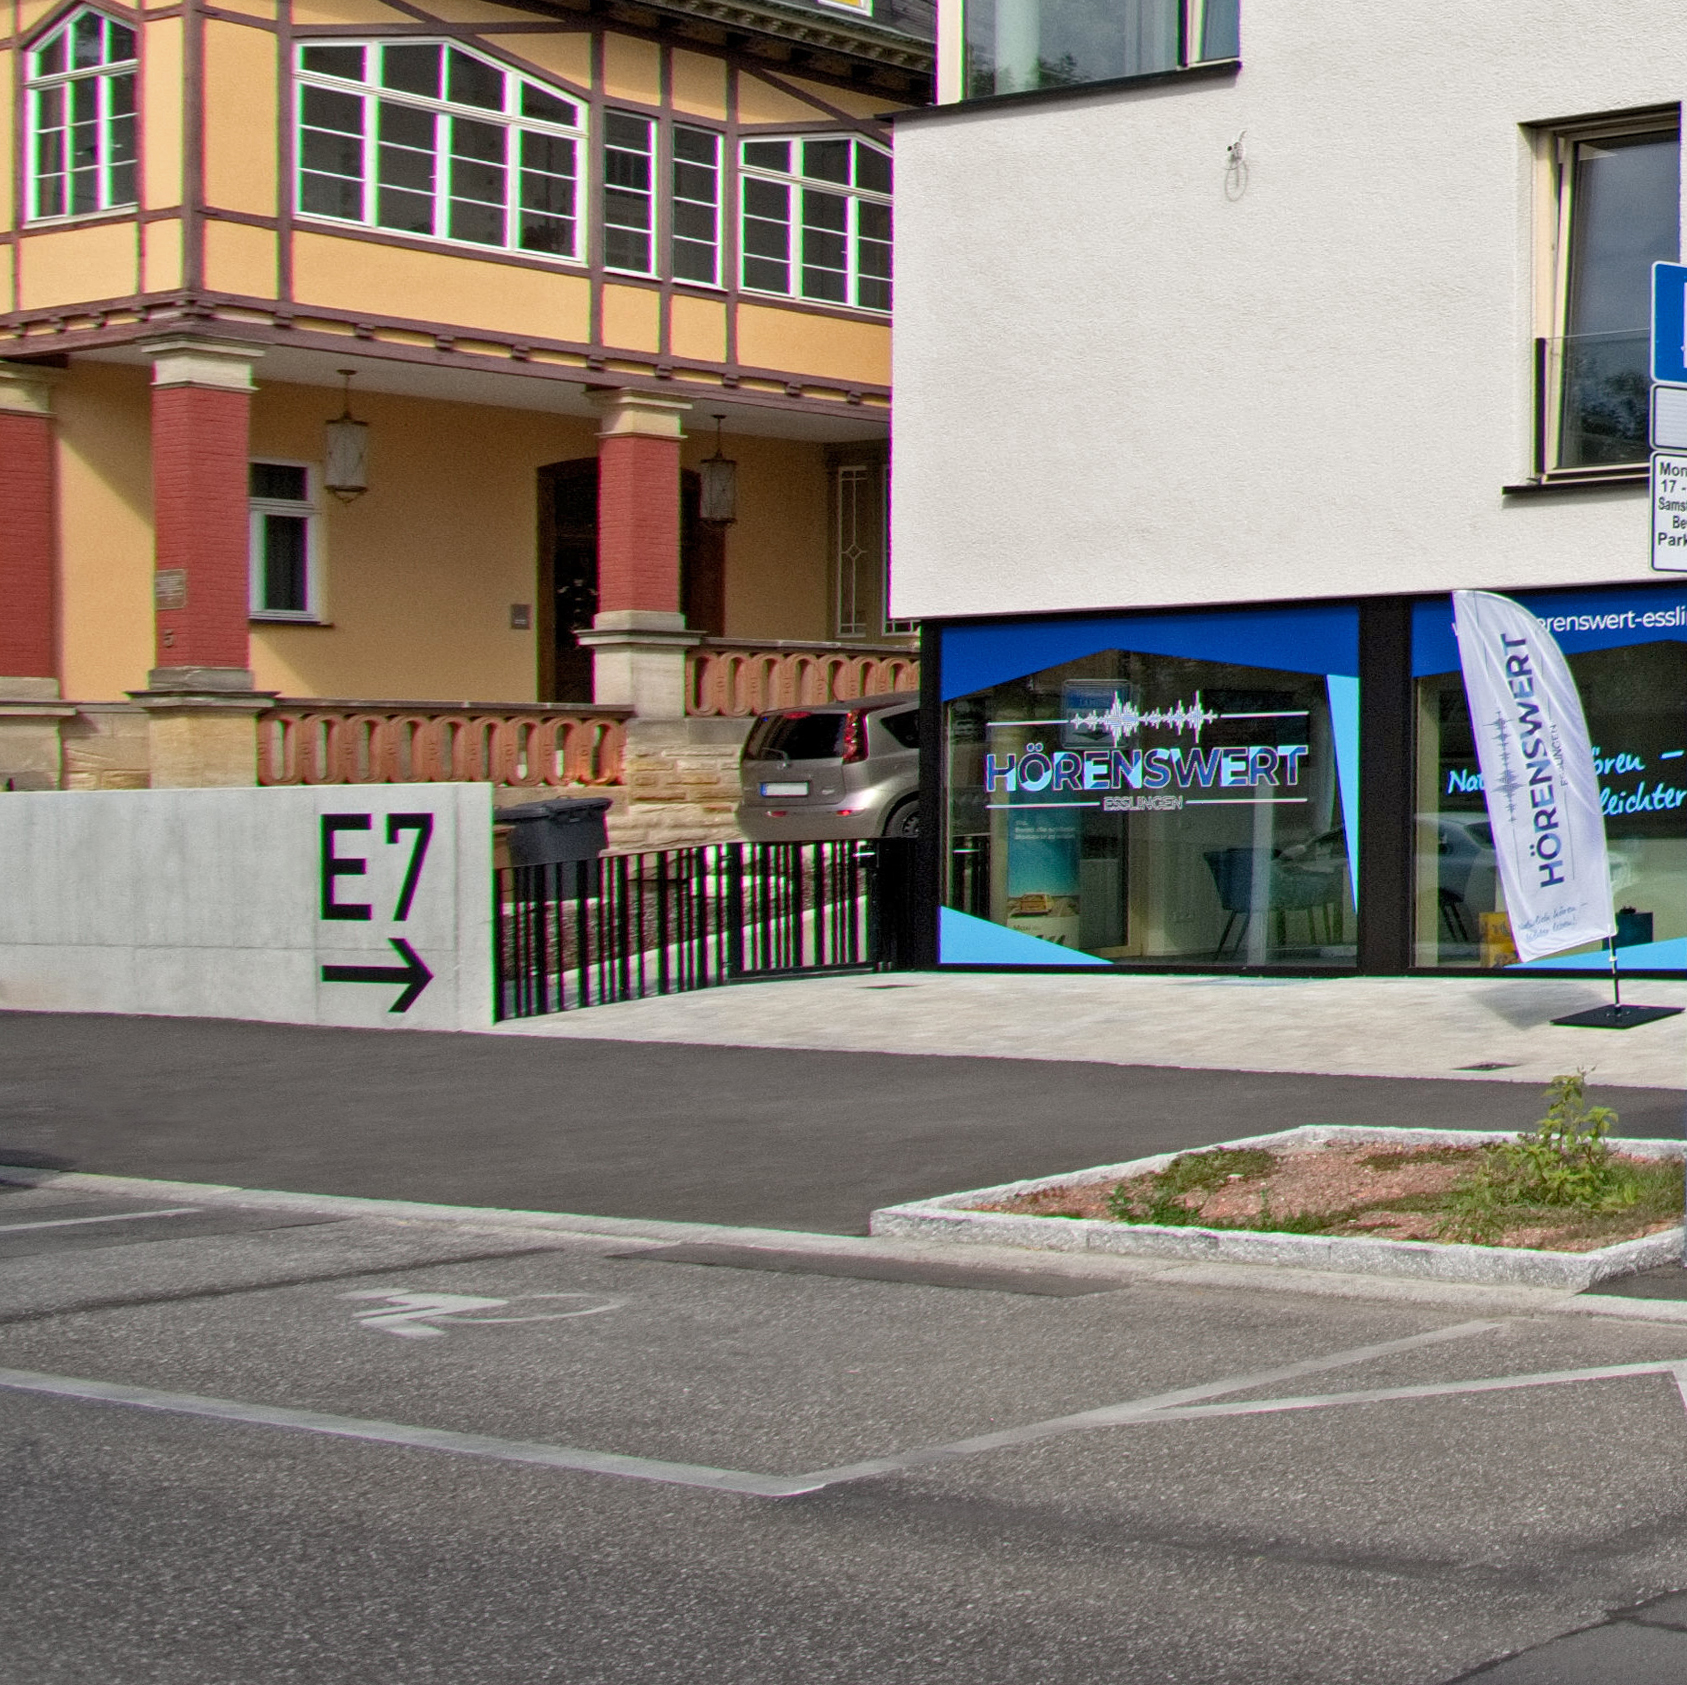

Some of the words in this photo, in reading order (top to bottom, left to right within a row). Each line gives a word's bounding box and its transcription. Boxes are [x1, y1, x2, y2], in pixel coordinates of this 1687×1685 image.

[1660, 479, 1676, 493] 17
[985, 742, 1309, 793] HÖRENSWERT
[1500, 633, 1565, 889] HÖRENSWERT
[1591, 746, 1646, 776] ören
[1103, 795, 1184, 811] ESSLINGEN
[1600, 780, 1687, 816] leichter
[321, 813, 433, 921] E7
